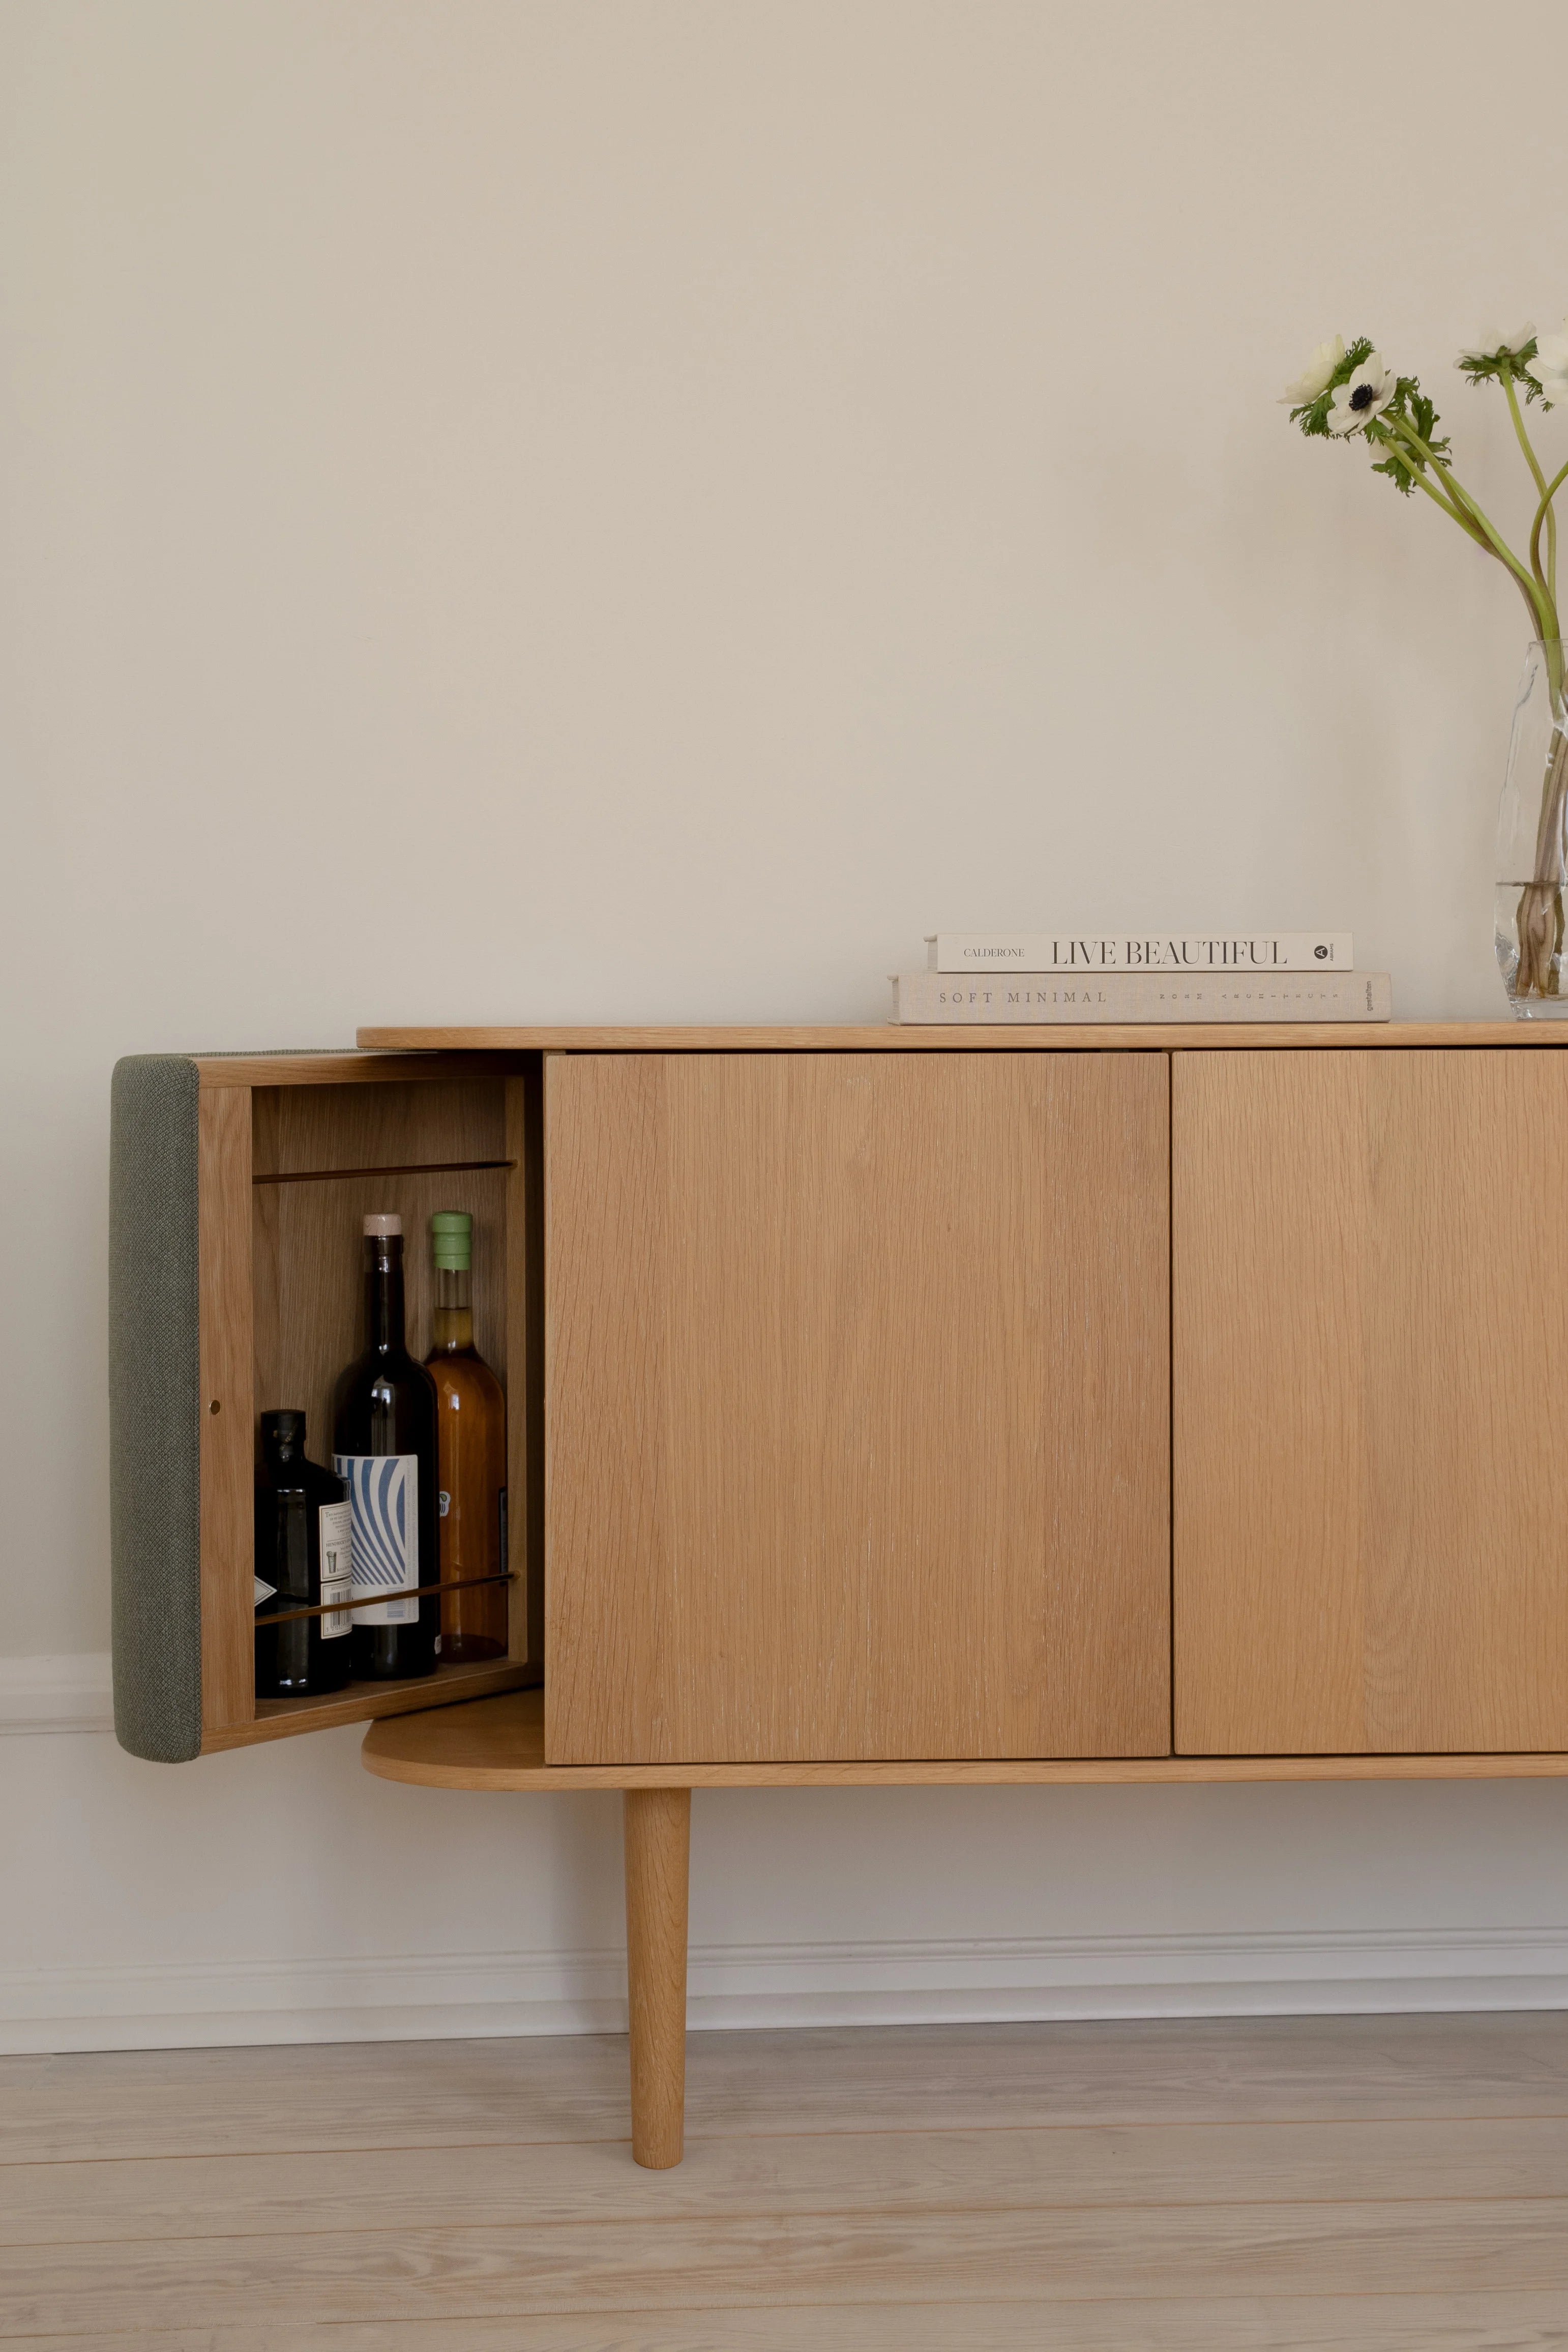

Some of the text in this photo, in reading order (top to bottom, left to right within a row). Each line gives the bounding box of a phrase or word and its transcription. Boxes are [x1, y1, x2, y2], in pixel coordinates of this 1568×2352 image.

[964, 948, 1025, 957] CALDERONE
[1051, 941, 1288, 964] LIVE BEAUTIFUL
[939, 992, 1107, 1004] SOFT MINIMAL
[1366, 981, 1374, 1011] gestalten
